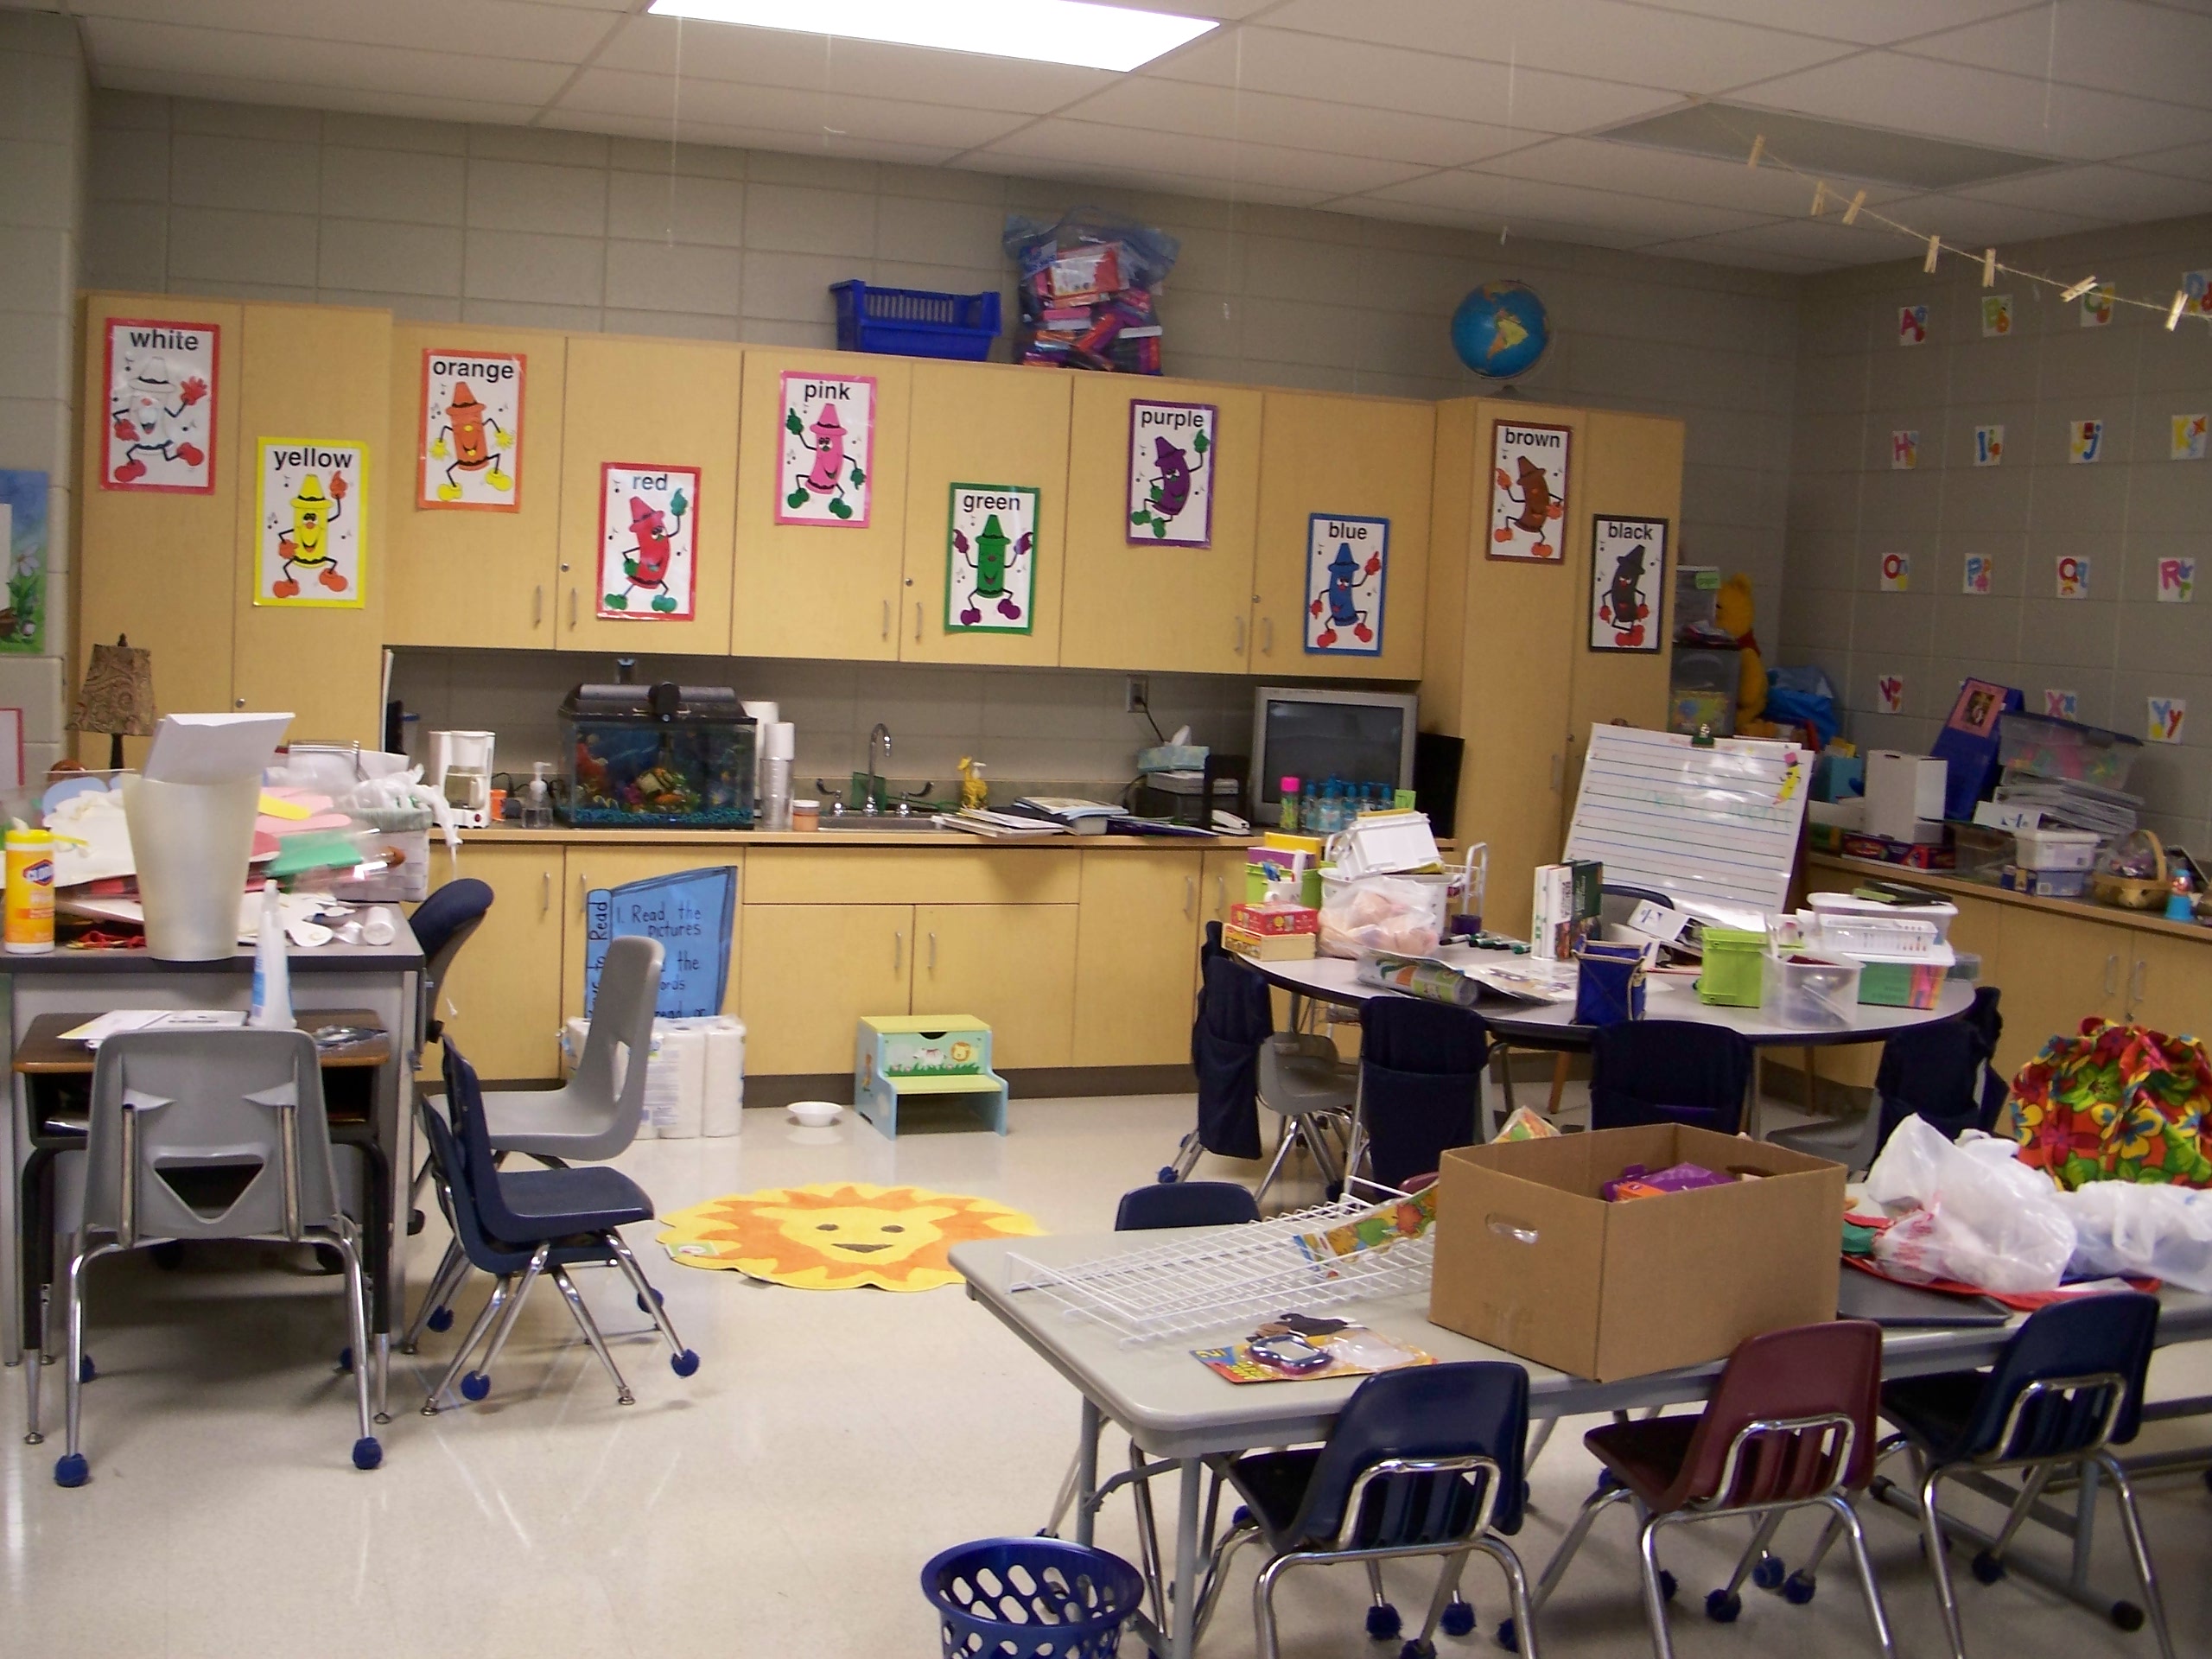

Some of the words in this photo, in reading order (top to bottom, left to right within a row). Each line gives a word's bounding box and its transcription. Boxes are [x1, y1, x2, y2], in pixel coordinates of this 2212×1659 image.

[130, 329, 199, 351] white
[433, 359, 513, 383] orange
[804, 381, 850, 402] pink
[1141, 410, 1205, 430] purple
[1505, 428, 1560, 448] brown
[273, 448, 353, 470] yellow
[632, 474, 668, 492] red
[963, 493, 1020, 512] green
[1328, 522, 1367, 540] blue
[1608, 522, 1653, 541] black
[588, 902, 608, 940] Read
[632, 901, 665, 923] Read
[678, 899, 702, 920] the
[648, 921, 702, 938] pictures
[677, 950, 700, 971] the
[660, 974, 685, 991] ords
